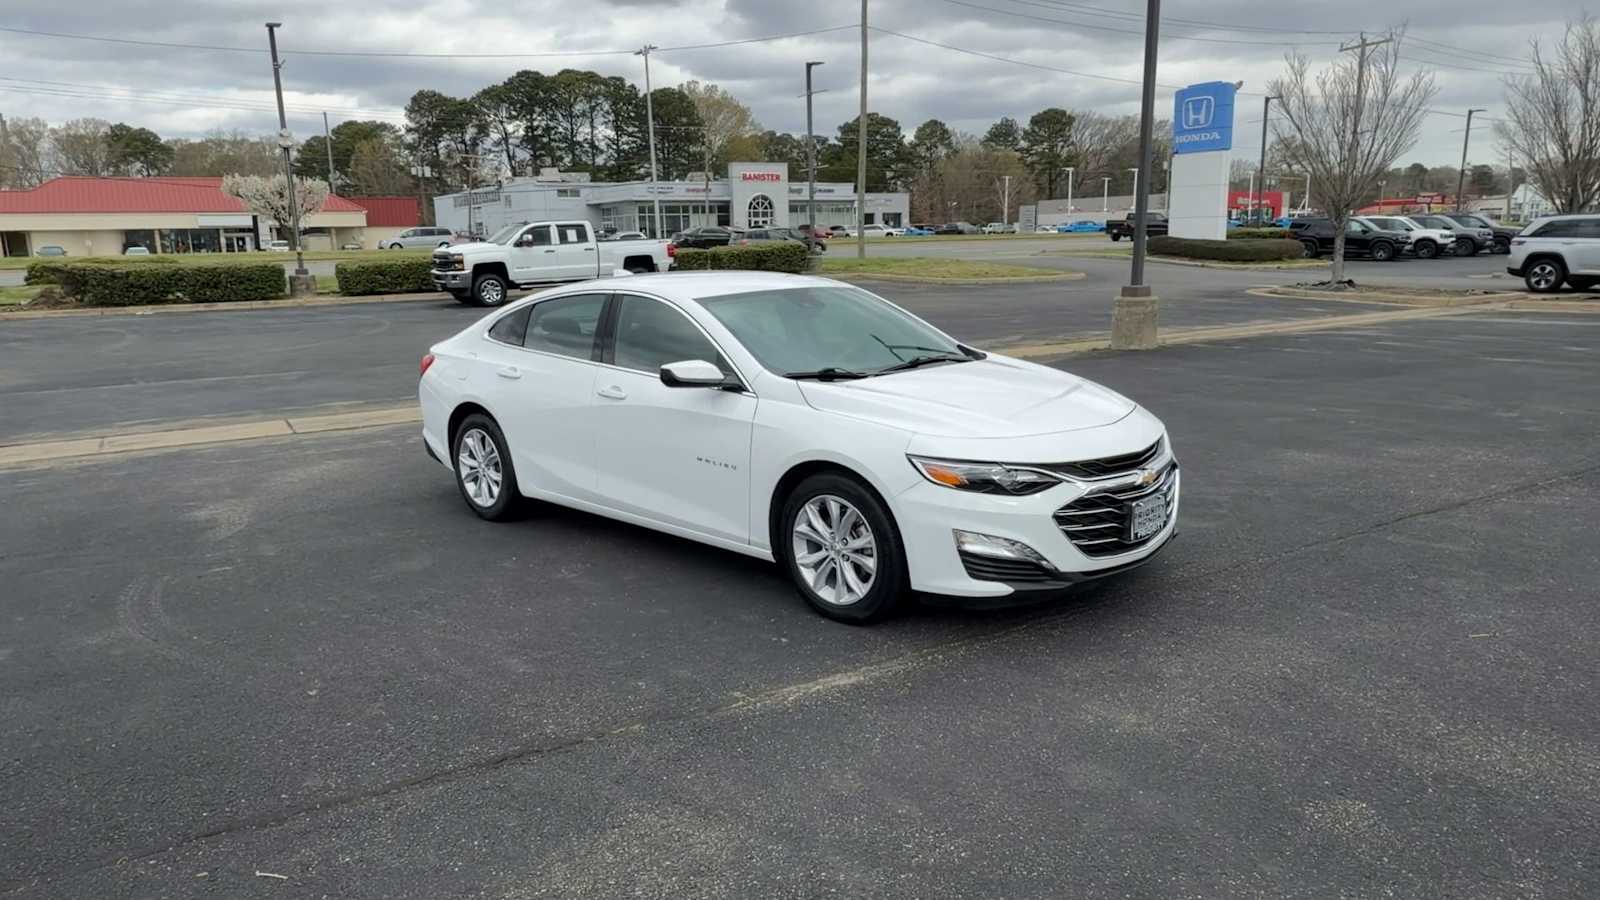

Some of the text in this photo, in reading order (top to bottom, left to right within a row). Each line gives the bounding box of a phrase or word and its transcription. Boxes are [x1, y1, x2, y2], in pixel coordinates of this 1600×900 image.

[1175, 131, 1221, 144] HONDA
[742, 172, 781, 181] BANISTER
[696, 456, 737, 471] MALIBU
